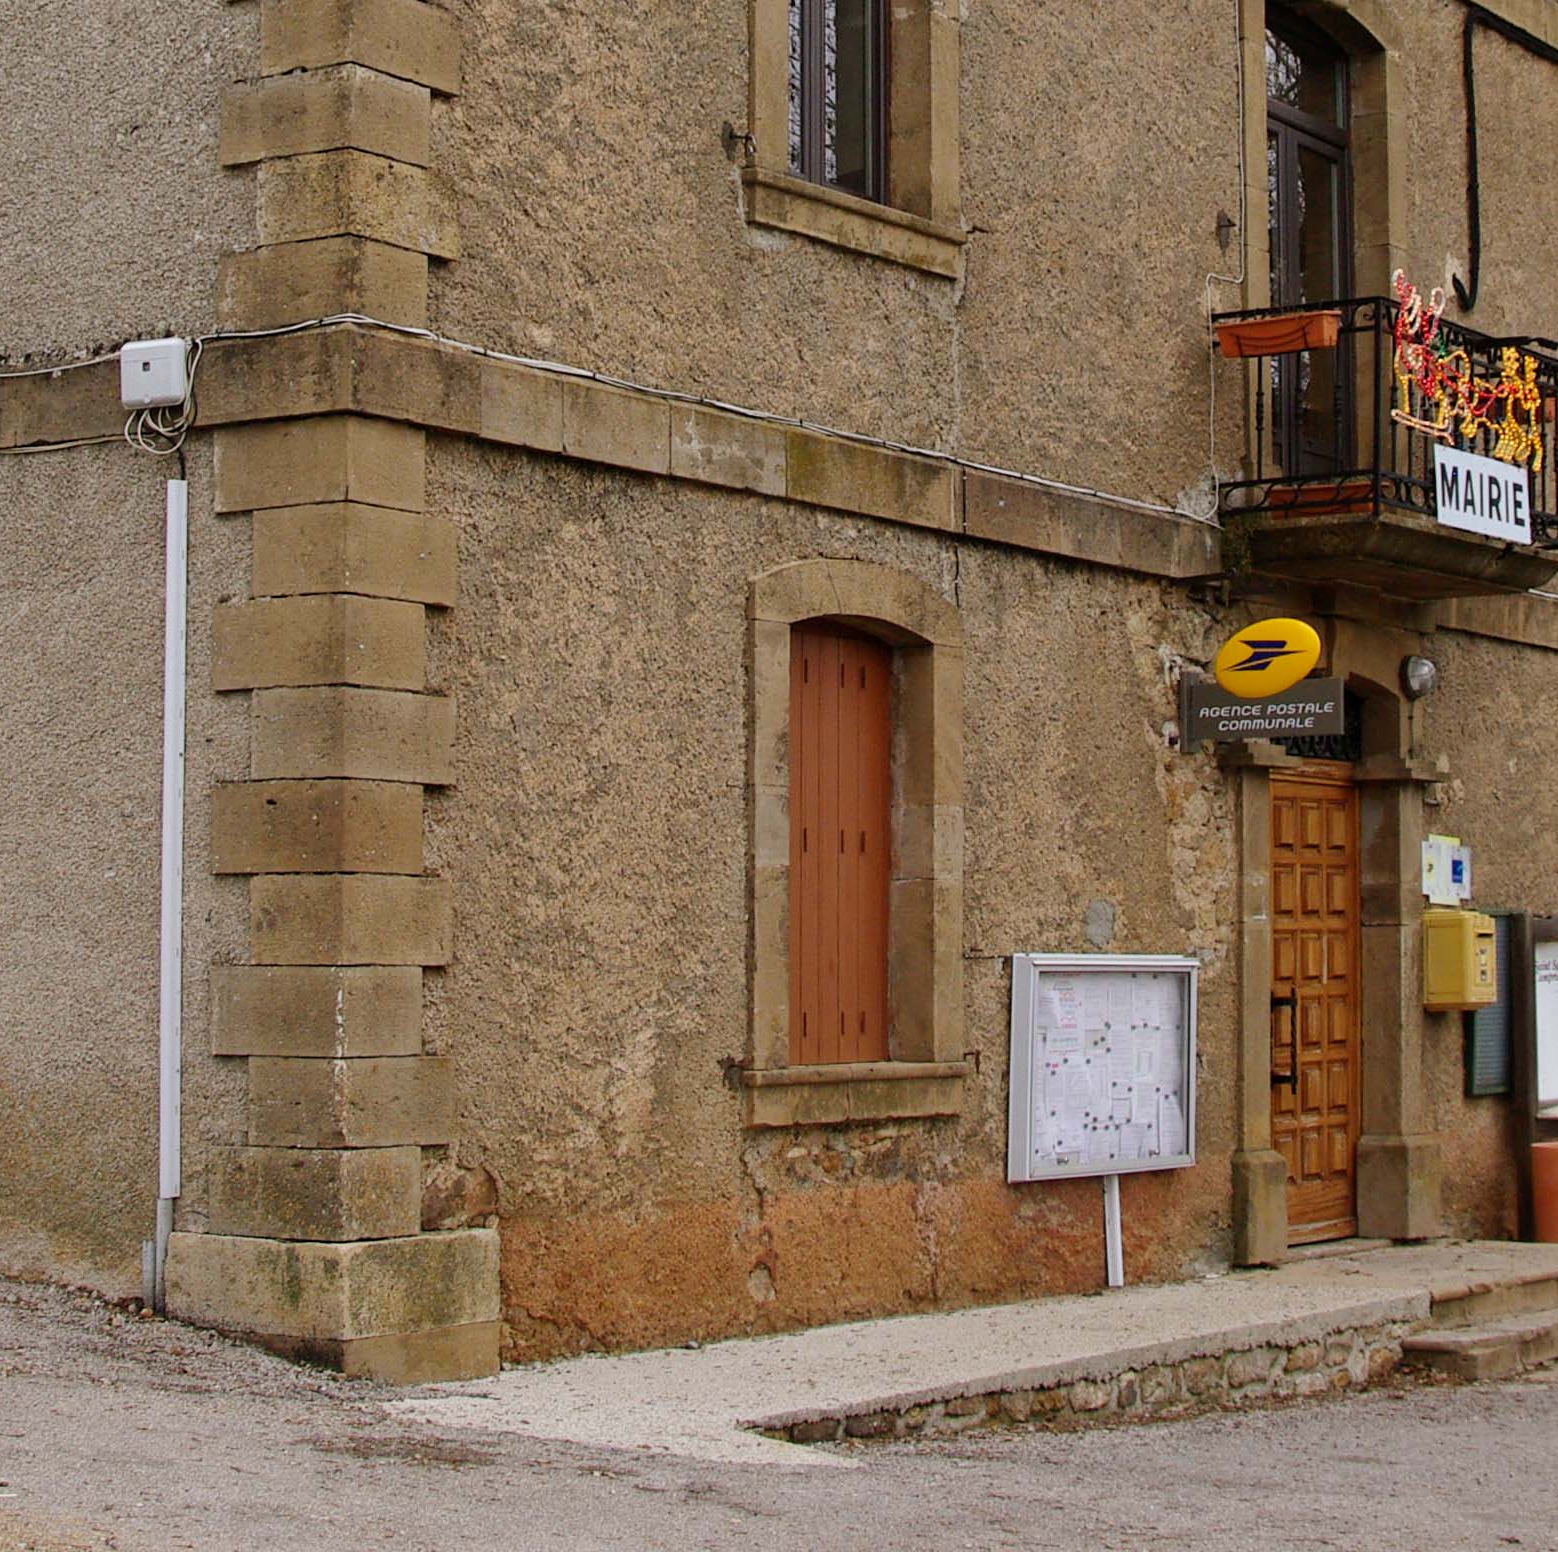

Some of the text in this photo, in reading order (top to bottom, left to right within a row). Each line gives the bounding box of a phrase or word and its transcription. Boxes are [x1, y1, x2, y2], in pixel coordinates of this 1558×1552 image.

[1440, 462, 1526, 527] MAIRIE
[1199, 702, 1336, 718] AGENCE POSTALE
[1218, 717, 1316, 731] COMMUNALE
